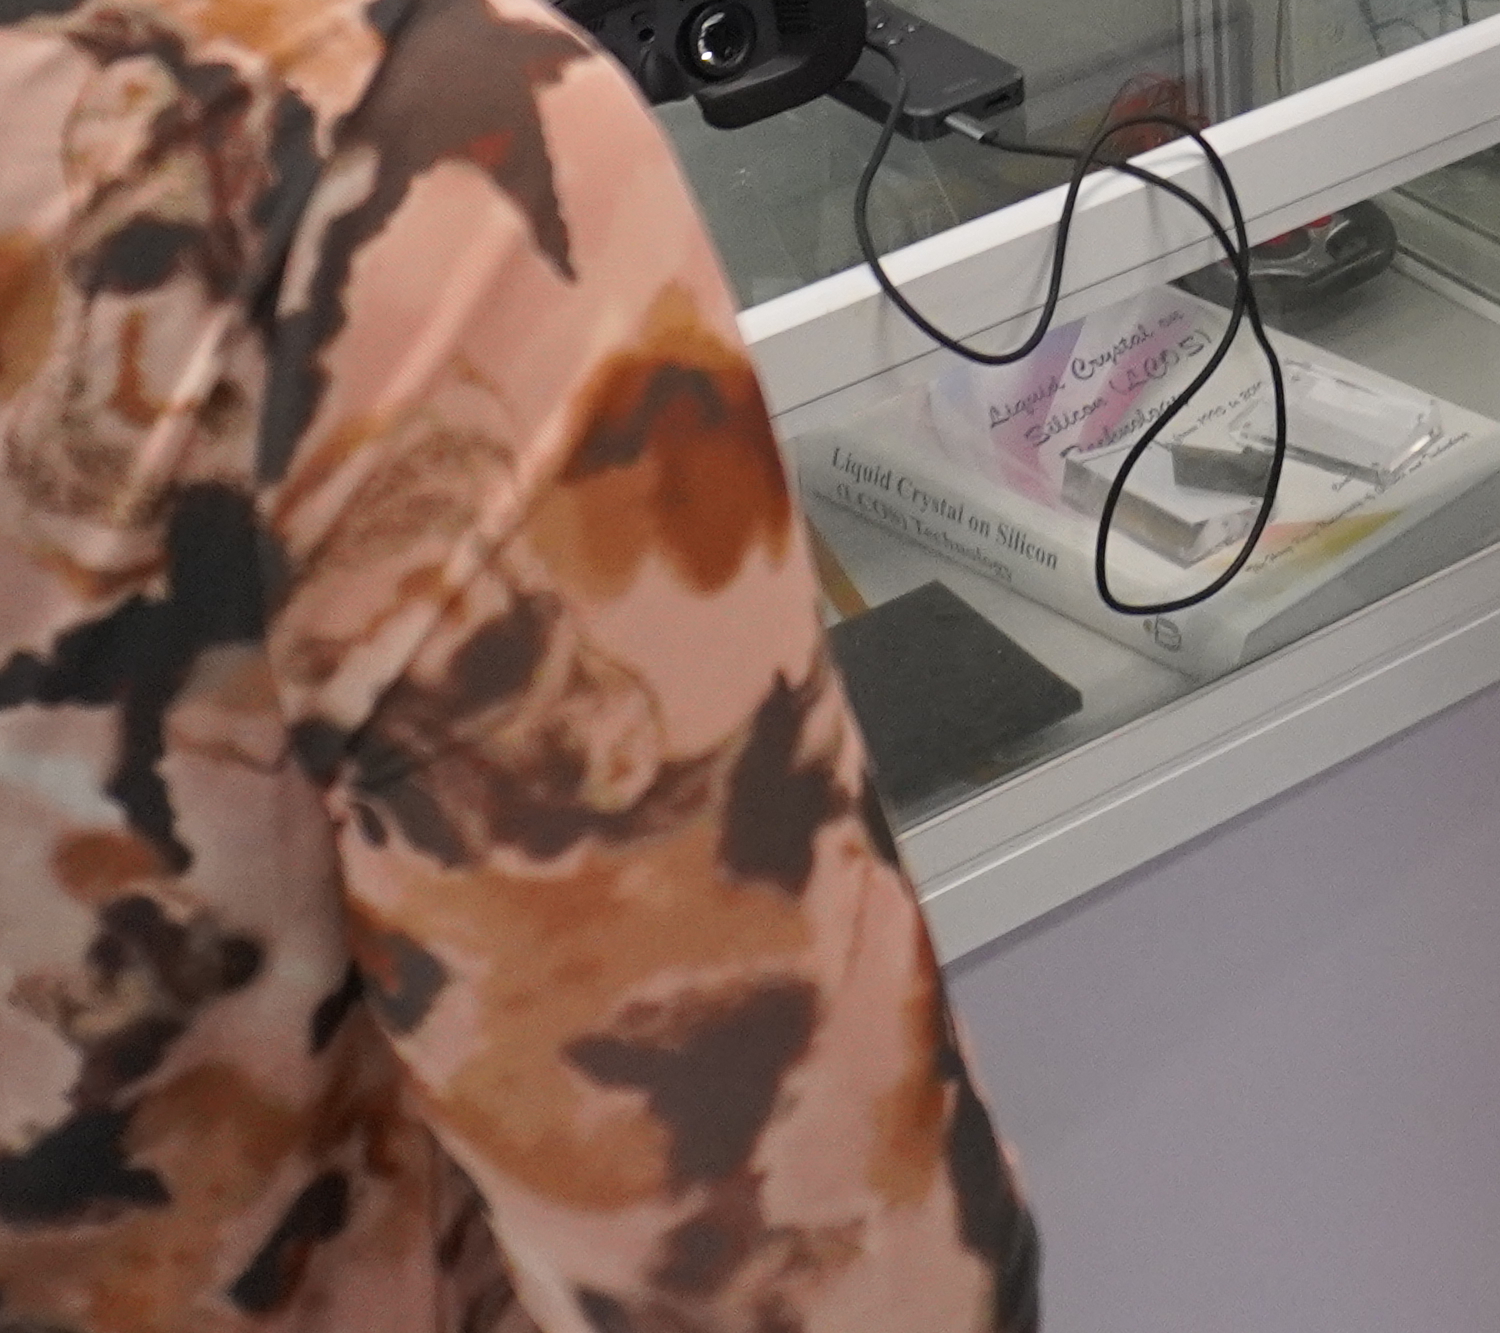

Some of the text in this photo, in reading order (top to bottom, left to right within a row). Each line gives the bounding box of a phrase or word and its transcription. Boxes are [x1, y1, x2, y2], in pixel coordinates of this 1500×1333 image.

[1072, 324, 1153, 380] Crystal
[1024, 397, 1107, 447] Silicon
[832, 447, 1058, 570] Liquid Crystal on Silicon
